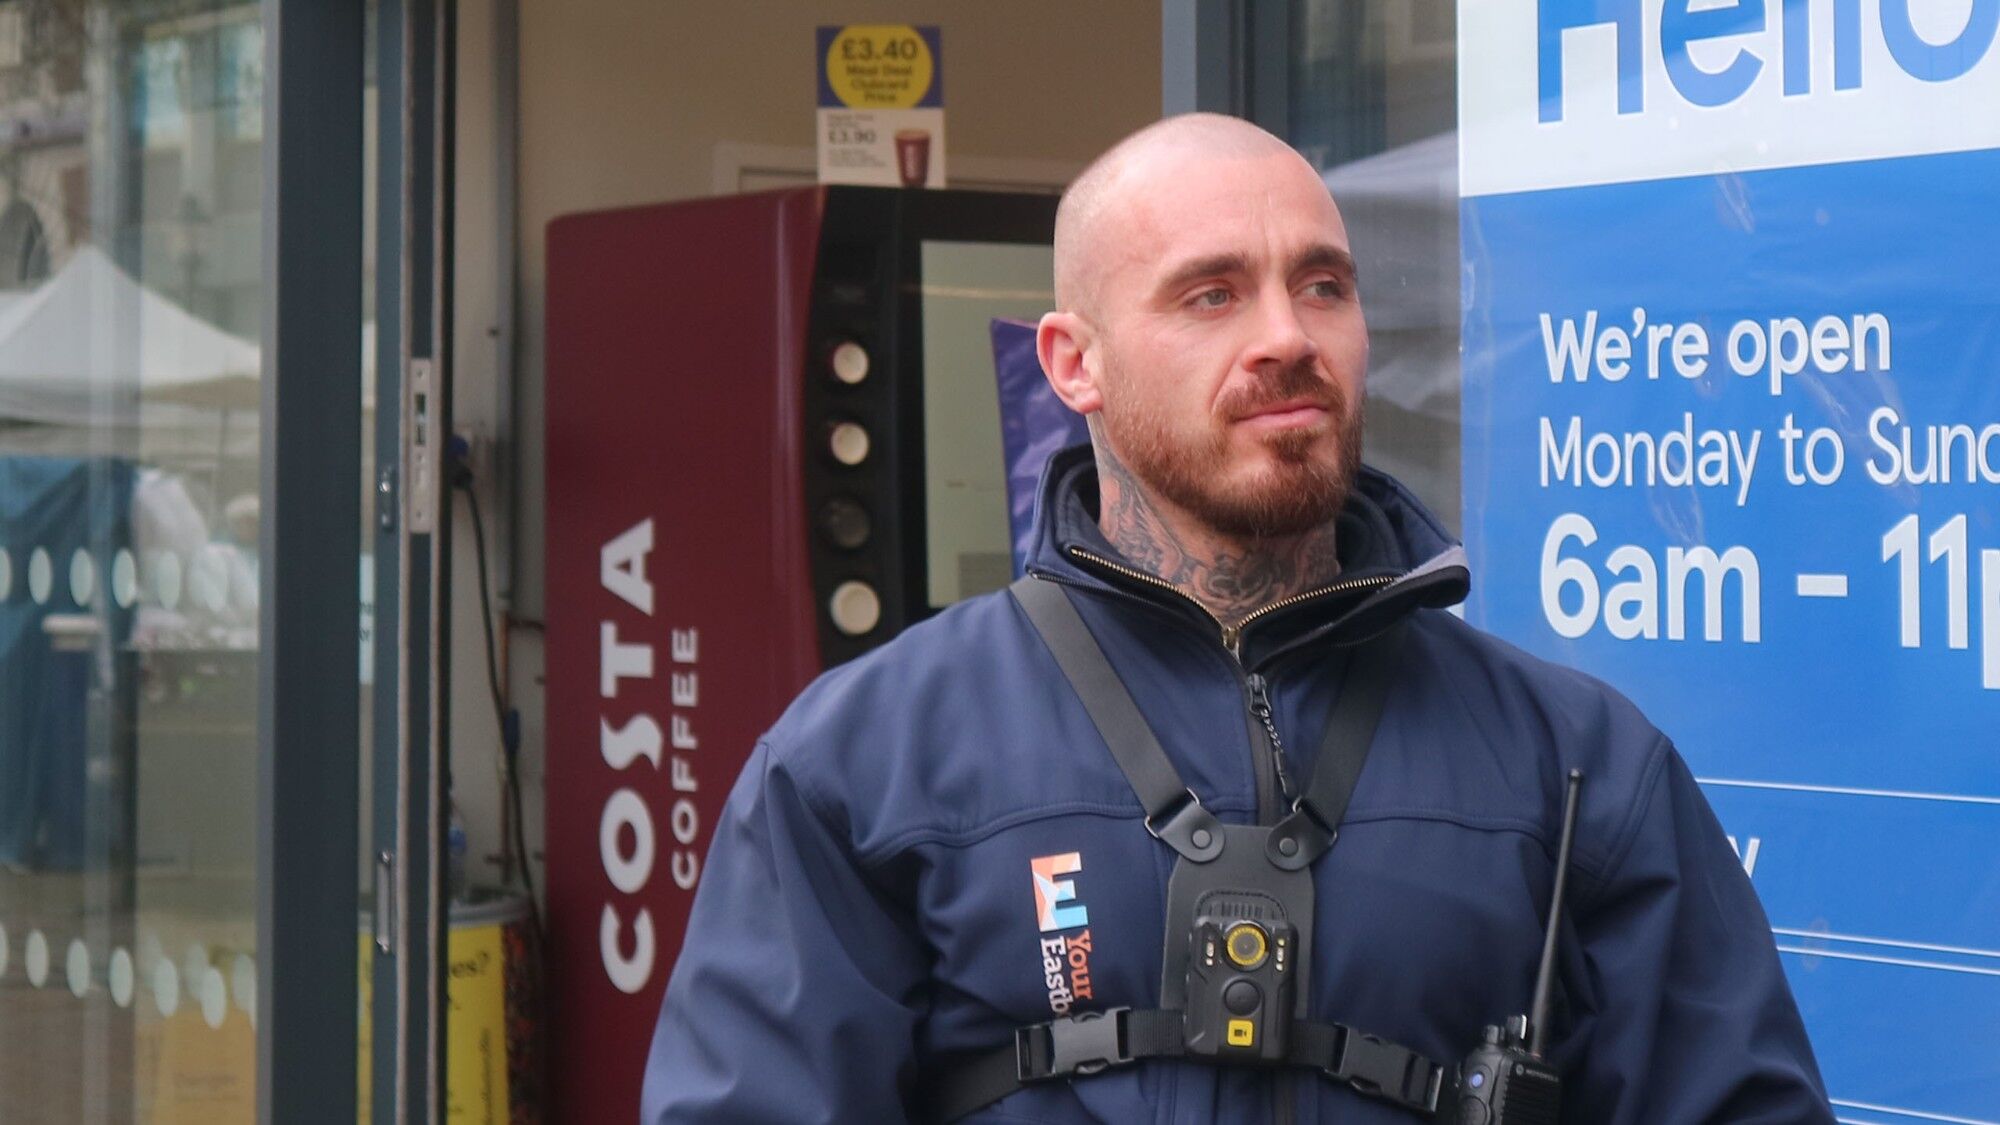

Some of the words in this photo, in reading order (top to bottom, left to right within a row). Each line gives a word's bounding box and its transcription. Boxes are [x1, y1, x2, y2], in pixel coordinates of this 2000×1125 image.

[842, 37, 919, 60] £3.40
[1727, 312, 1891, 395] open
[1539, 412, 1761, 506] Monday
[1778, 413, 1845, 485] to
[1540, 513, 1761, 642] 6am
[1881, 513, 2000, 689] 11
[600, 517, 664, 994] COSTA
[671, 627, 698, 890] COFFEE
[1040, 935, 1074, 1014] Eastb
[1065, 929, 1093, 1001] Your
